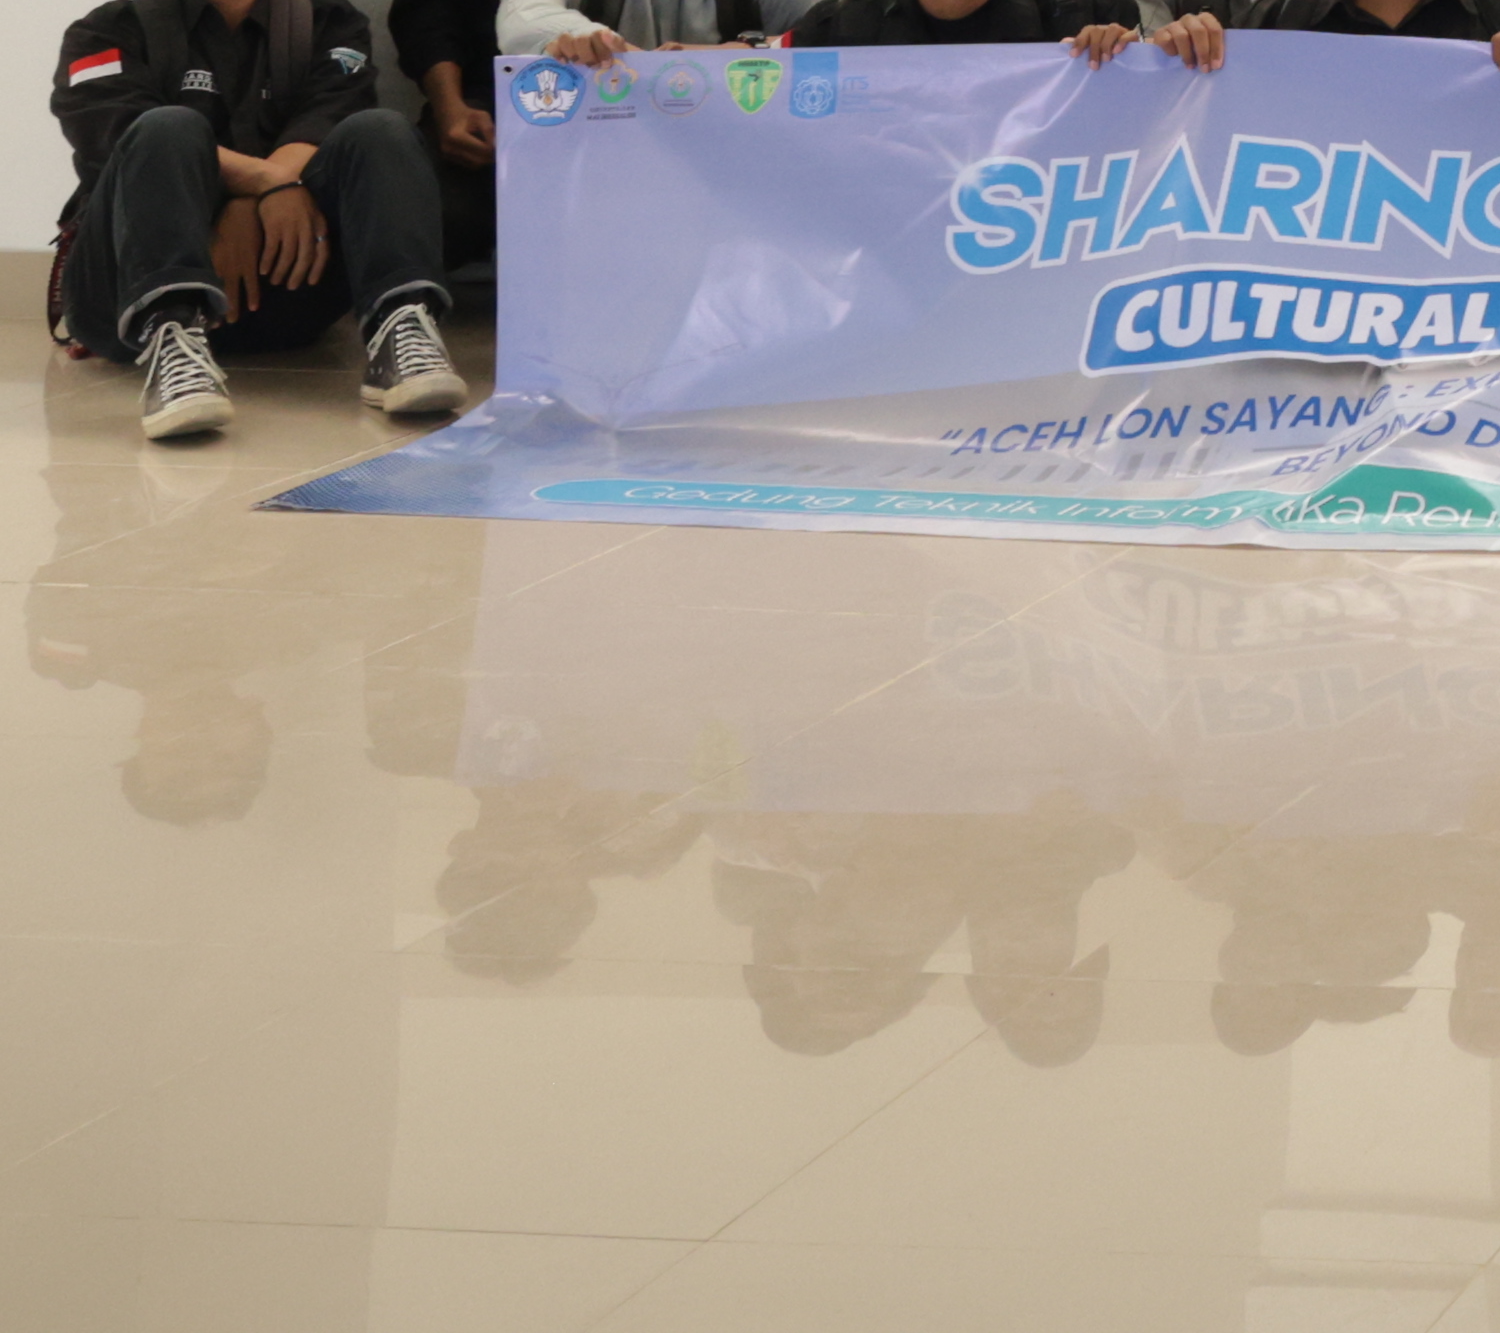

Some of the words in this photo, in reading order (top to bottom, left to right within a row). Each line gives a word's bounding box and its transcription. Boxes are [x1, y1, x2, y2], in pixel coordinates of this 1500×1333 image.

[1116, 284, 1496, 350] CULTURAL
[1099, 404, 1190, 445] LON
[1201, 384, 1391, 434] SAYANG
[1270, 408, 1457, 478] BEYOND
[623, 484, 856, 511] Gedung
[874, 494, 1052, 517] Teknik
